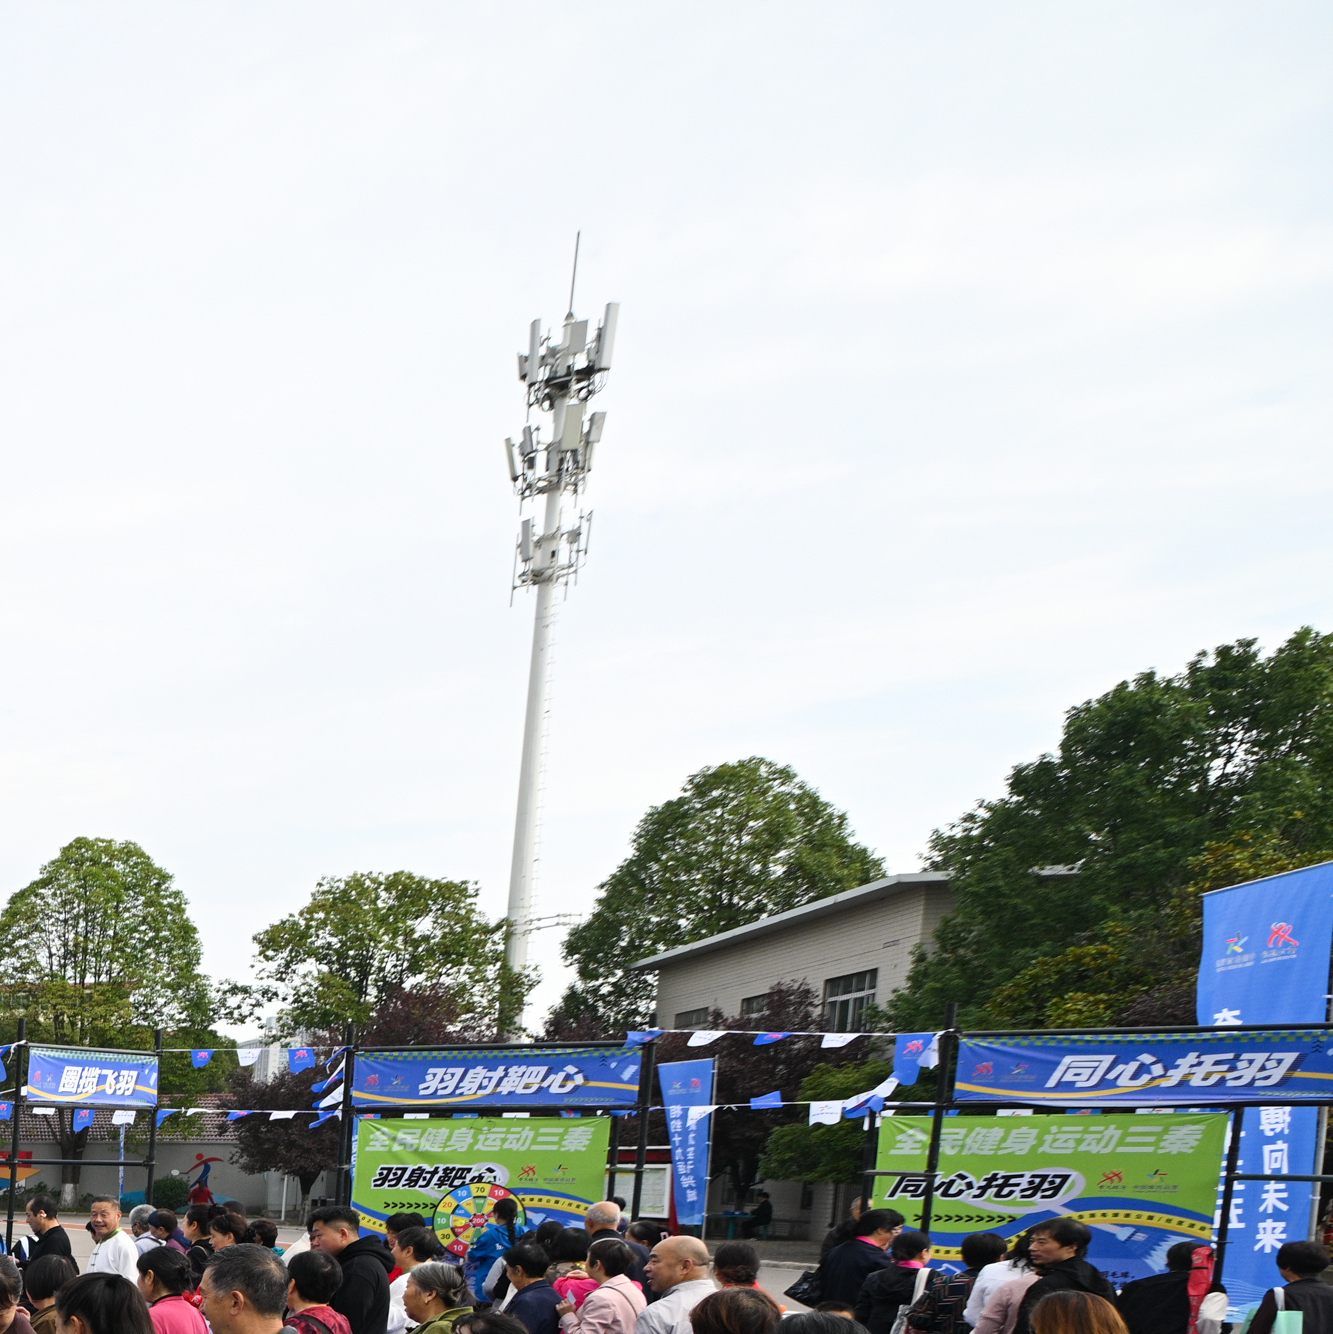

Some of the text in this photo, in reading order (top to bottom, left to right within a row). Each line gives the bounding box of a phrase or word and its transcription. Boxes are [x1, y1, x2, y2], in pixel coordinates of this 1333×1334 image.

[58, 1065, 139, 1096] 圈揽飞羽
[418, 1064, 584, 1095] 羽射靶心
[1044, 1051, 1300, 1090] 同心托羽
[365, 1126, 595, 1152] 全民健身运动三秦
[889, 1125, 1207, 1156] 全民健身运动三秦
[886, 1172, 1072, 1200] 同心托羽
